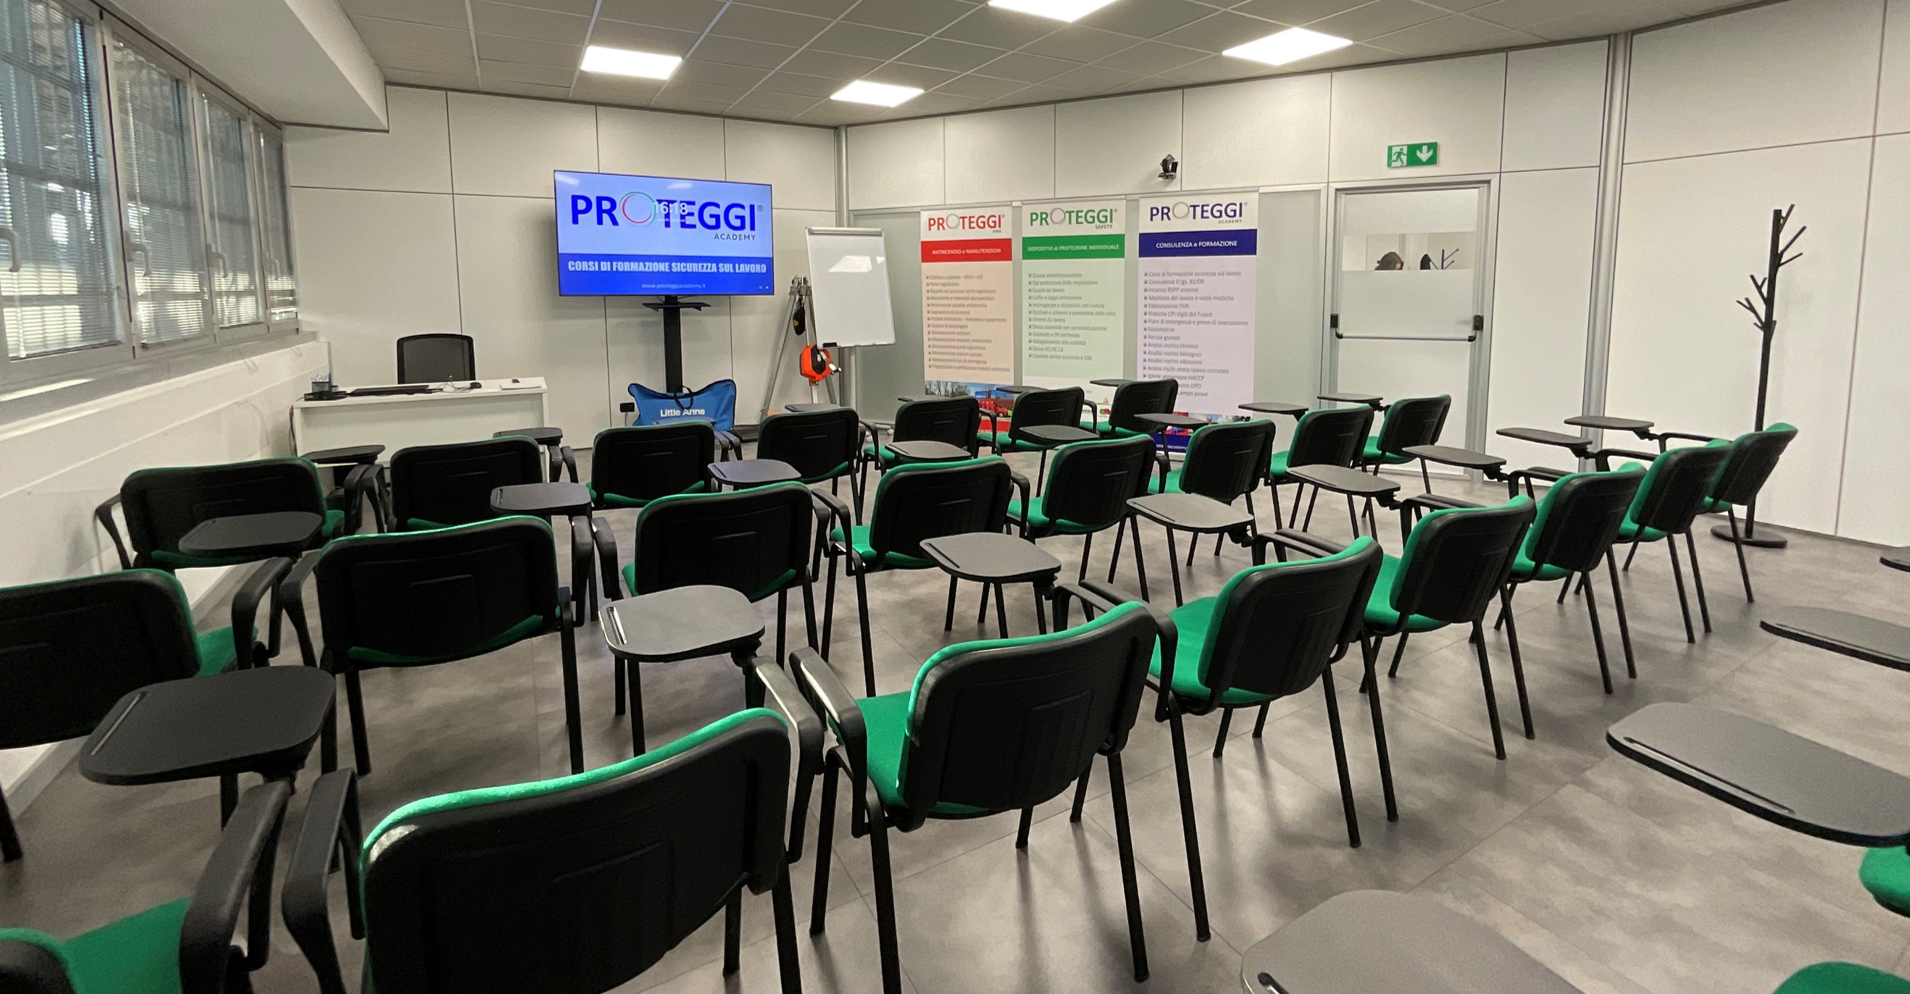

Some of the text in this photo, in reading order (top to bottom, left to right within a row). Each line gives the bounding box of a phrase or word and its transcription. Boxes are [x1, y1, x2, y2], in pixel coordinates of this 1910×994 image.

[653, 202, 688, 215] 16:18
[568, 261, 766, 273] CORSI DI FORMAZIONE SICUREZZA SUL LAVORO
[661, 409, 680, 417] Little
